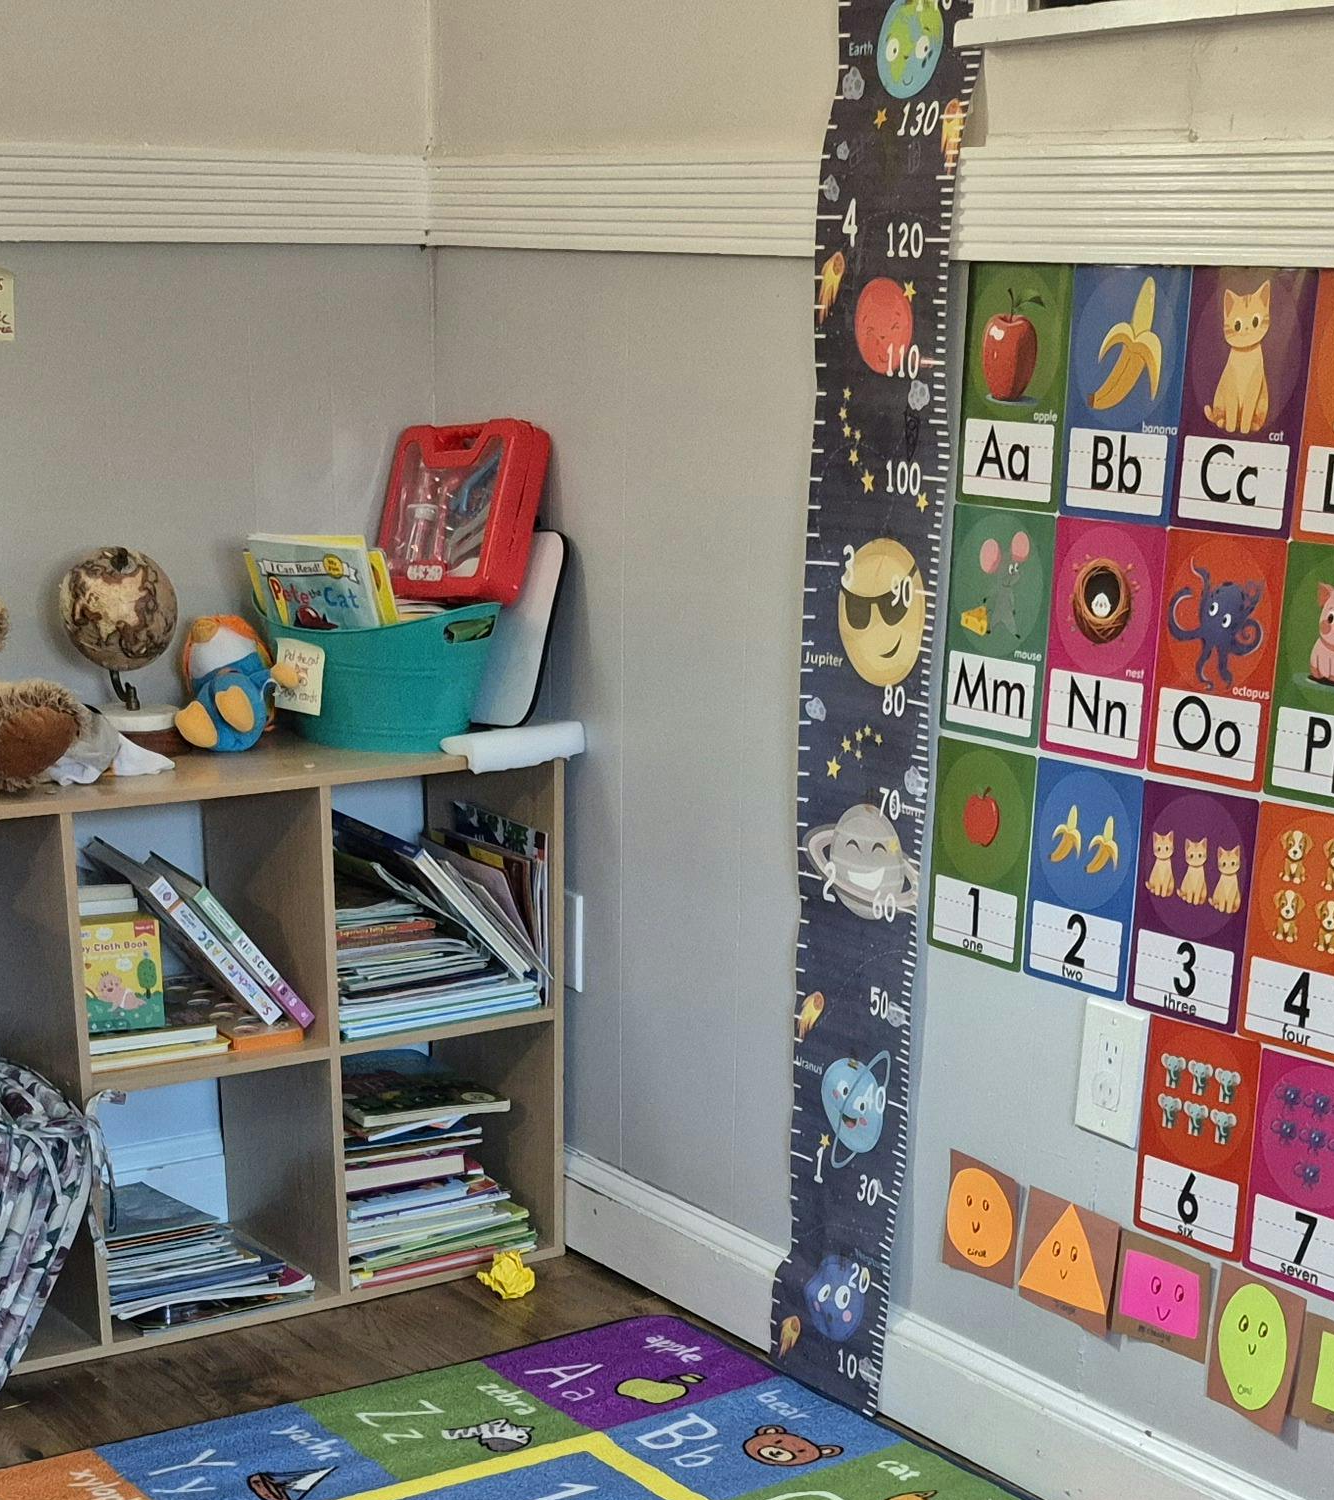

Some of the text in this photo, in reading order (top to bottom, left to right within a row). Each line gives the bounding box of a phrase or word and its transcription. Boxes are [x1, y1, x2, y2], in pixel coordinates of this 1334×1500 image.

[849, 42, 873, 56] Earth
[897, 101, 940, 137] 130
[887, 222, 924, 258] 120
[886, 345, 920, 379] 110
[1033, 410, 1057, 423] apple
[1142, 422, 1177, 436] banana
[1268, 431, 1284, 442] cat
[976, 425, 1029, 482] Aa
[1090, 435, 1142, 494] Bb
[885, 461, 921, 496] 100
[1200, 443, 1258, 506] Cc
[276, 564, 294, 573] Can
[296, 563, 320, 572] Read!
[324, 587, 359, 608] Cat
[890, 575, 914, 607] 90
[803, 651, 844, 668] Jupiter
[1014, 649, 1042, 662] mouse
[953, 657, 1026, 719] Mm
[1125, 668, 1144, 679] nest
[882, 685, 906, 716] 80
[1067, 675, 1128, 739] Nn
[1232, 685, 1270, 700] octopus
[1172, 695, 1242, 758] Oo
[879, 787, 901, 820] 70
[966, 887, 980, 938] 1
[94, 941, 147, 951] Cloth Book
[962, 939, 983, 953] one
[1064, 913, 1087, 967] 2
[1061, 964, 1083, 982] two
[1173, 941, 1197, 997] 3
[869, 986, 889, 1020] 50
[1163, 995, 1197, 1016] three
[1283, 971, 1311, 1028] 4
[1281, 1022, 1311, 1046] four
[857, 1174, 879, 1206] 30
[1177, 1173, 1199, 1224] 6
[1176, 1223, 1194, 1239] six
[1293, 1212, 1318, 1265] 7
[1280, 1261, 1319, 1285] seven
[644, 1334, 704, 1364] apple
[837, 1349, 858, 1378] 10
[475, 1383, 538, 1416] zebra
[755, 1389, 806, 1422] bear
[271, 1424, 343, 1462] yacht
[876, 1458, 921, 1482] cat
